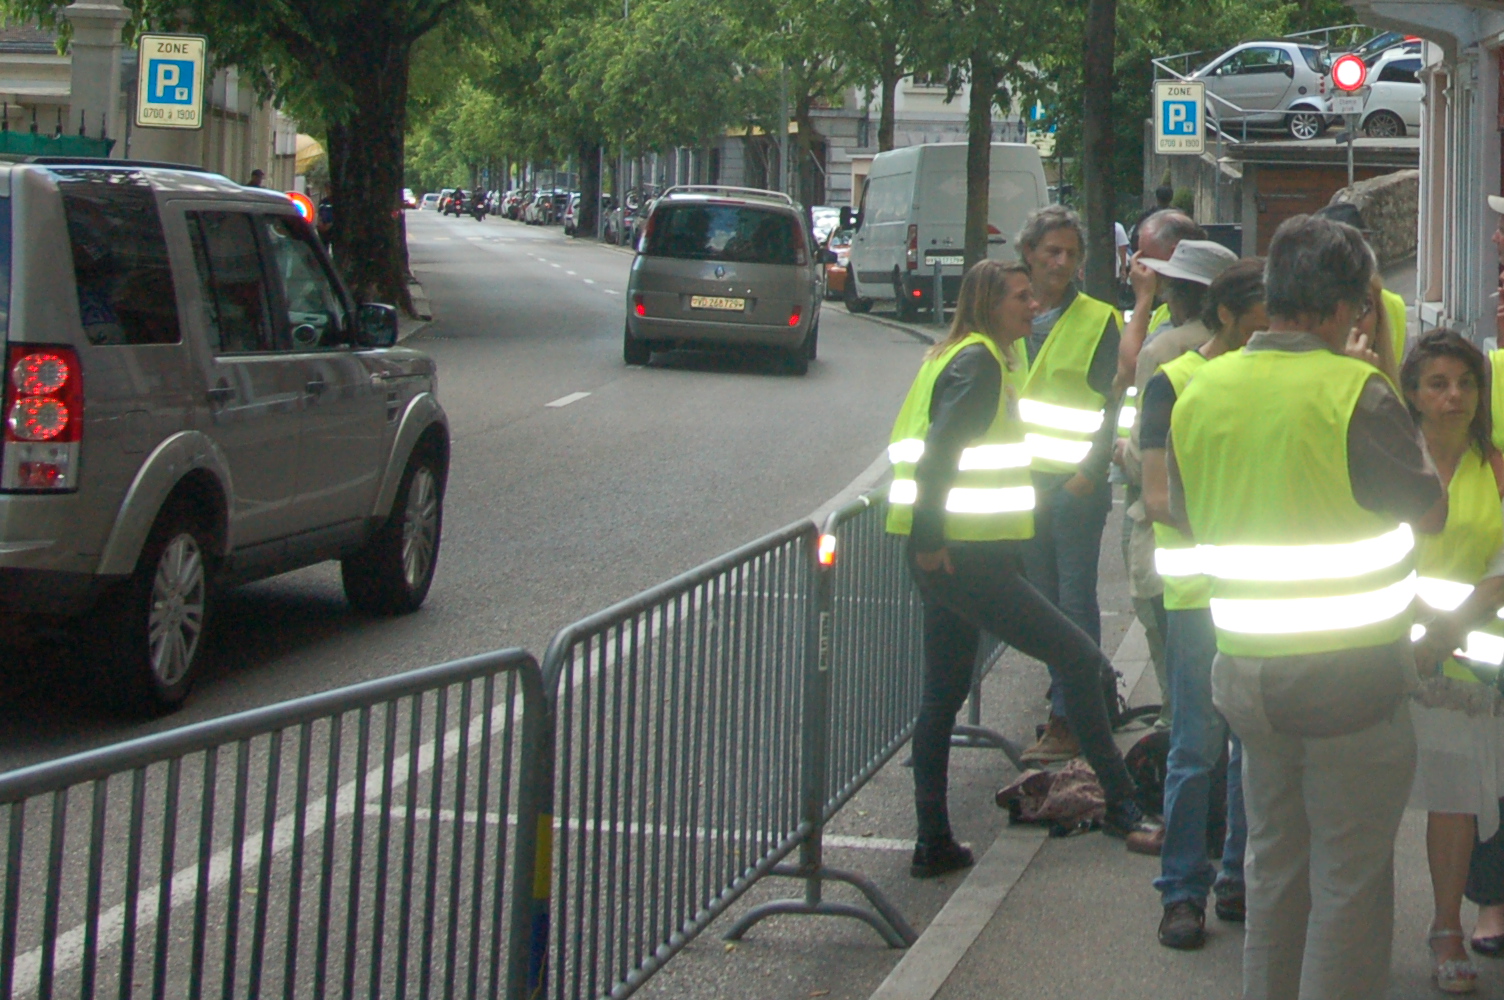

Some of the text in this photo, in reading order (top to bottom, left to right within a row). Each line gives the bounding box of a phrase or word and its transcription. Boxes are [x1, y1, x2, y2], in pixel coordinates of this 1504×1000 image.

[157, 42, 189, 54] ZONE
[156, 63, 180, 97] P
[1168, 87, 1191, 96] ZONE
[143, 108, 164, 119] 0700
[177, 109, 196, 120] 1900
[1169, 104, 1186, 131] P
[1160, 139, 1176, 147] 0700
[1185, 139, 1200, 147] 1900
